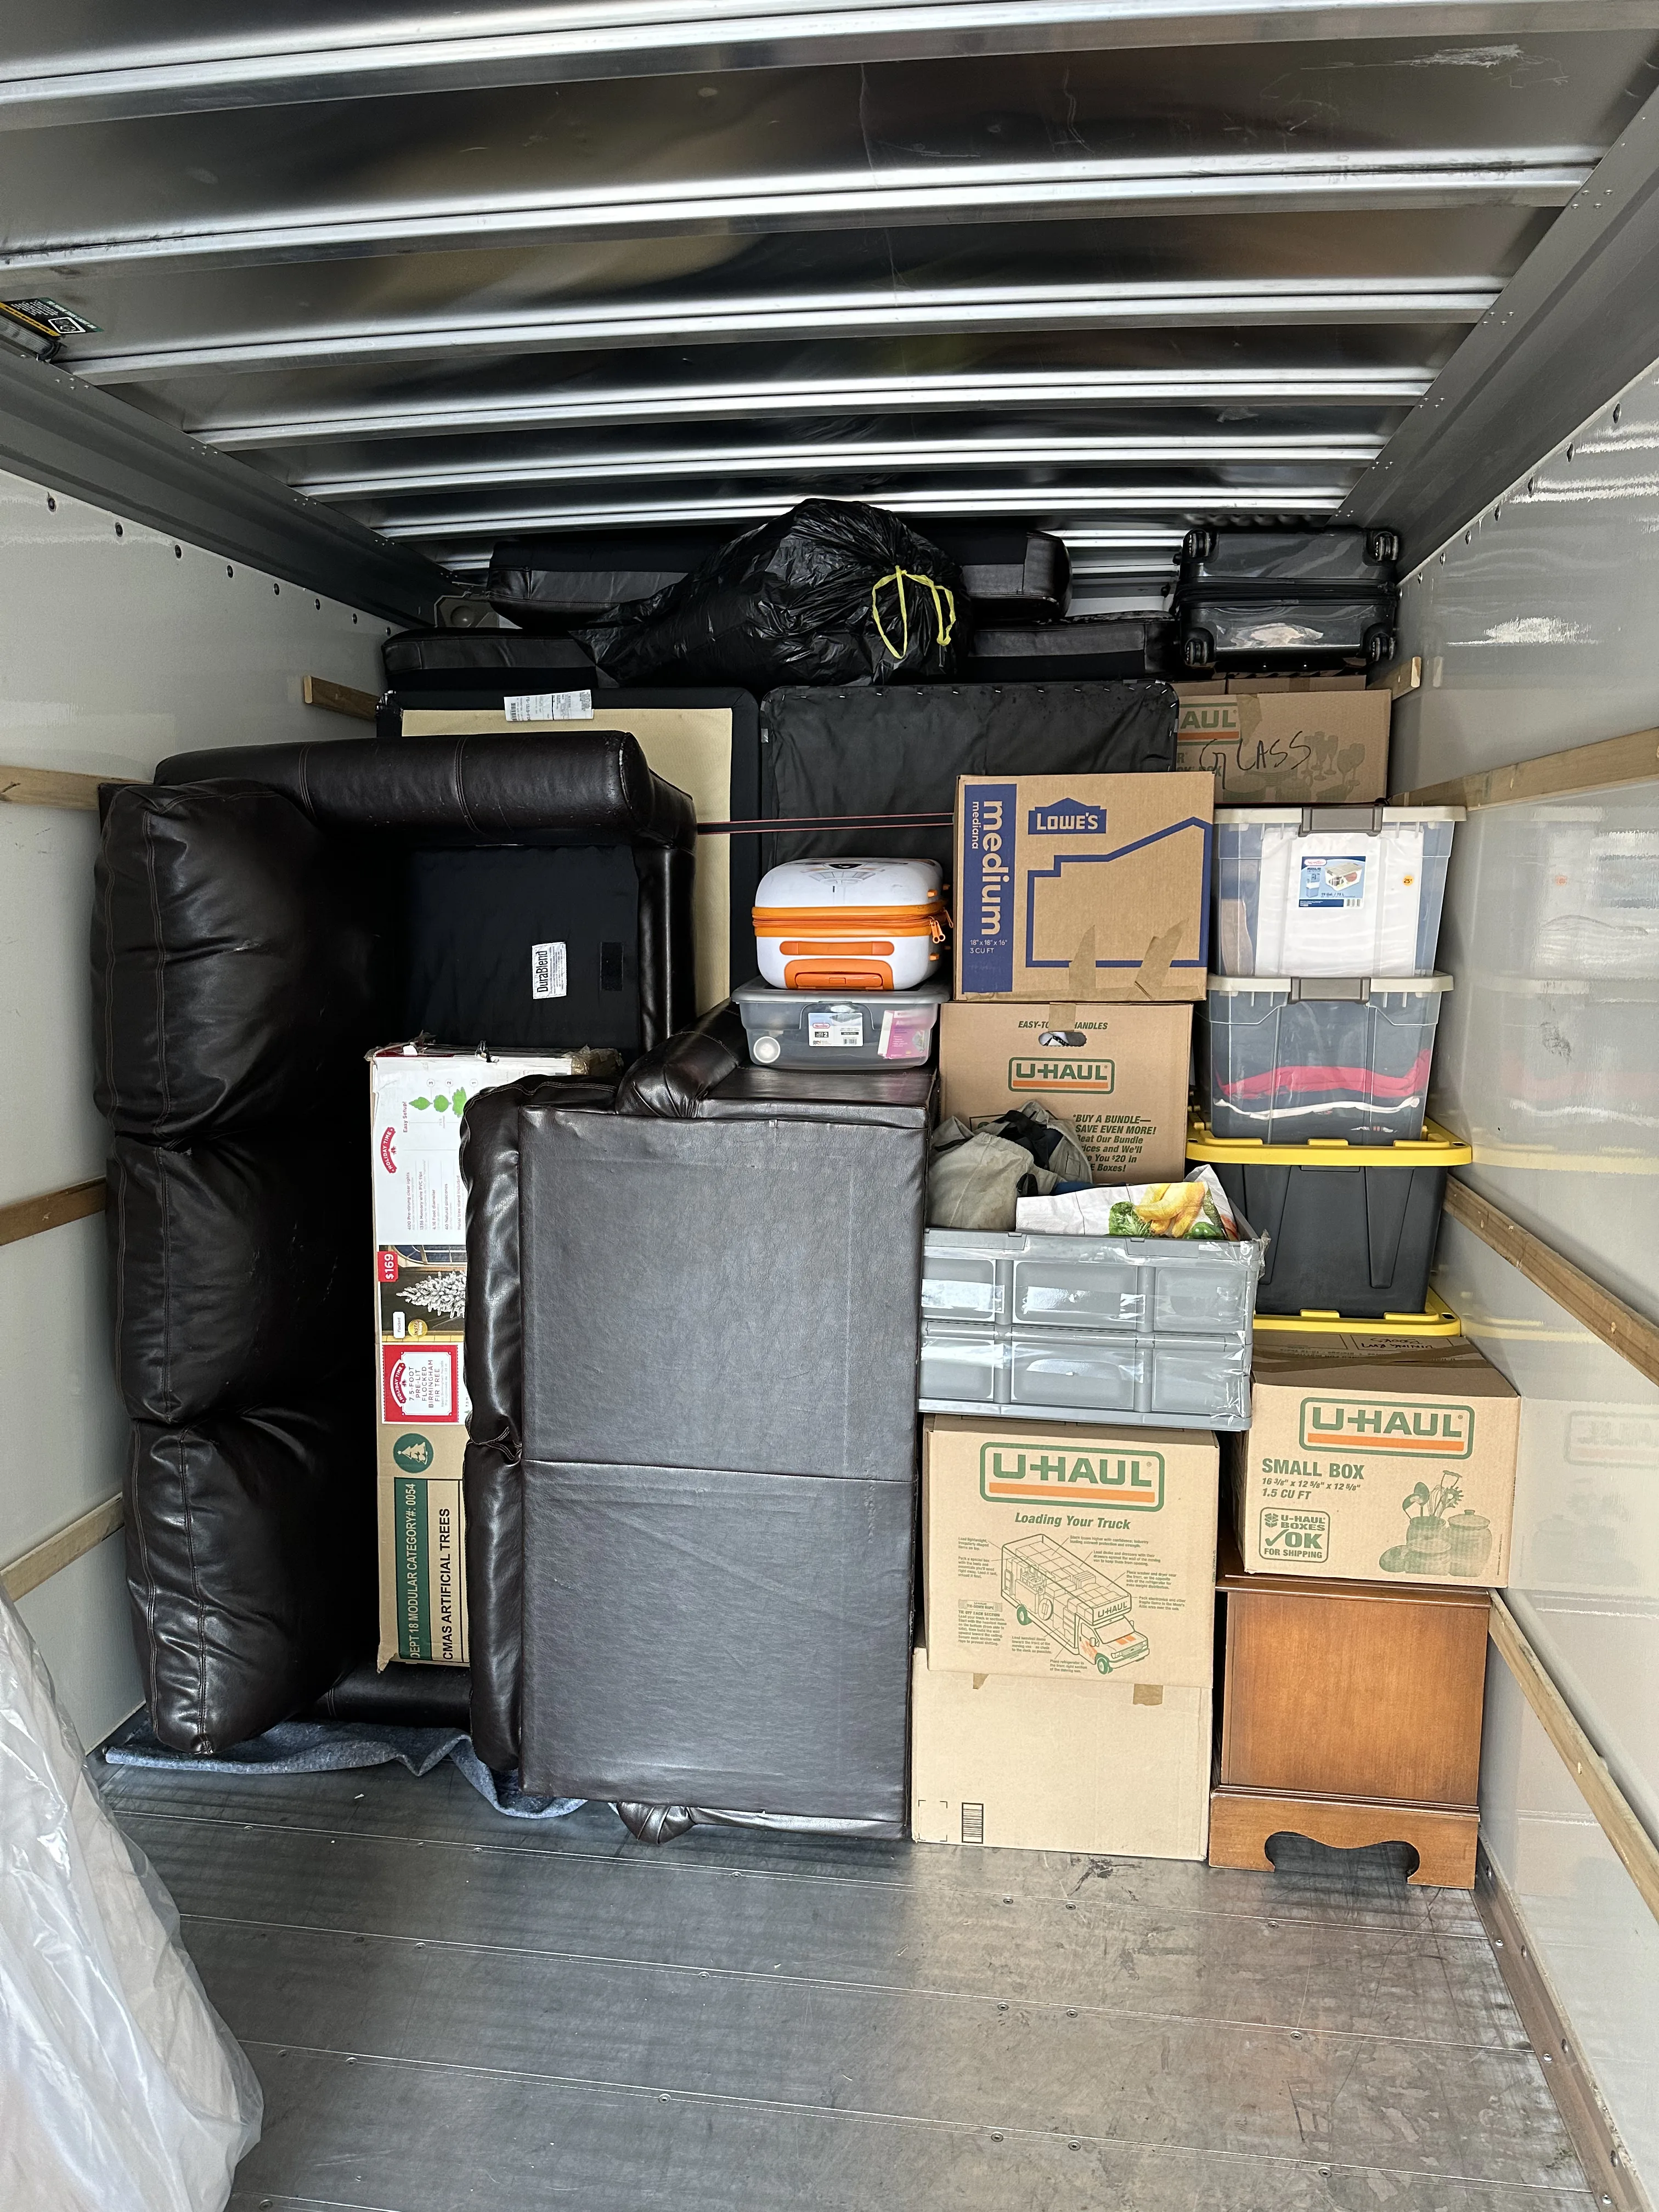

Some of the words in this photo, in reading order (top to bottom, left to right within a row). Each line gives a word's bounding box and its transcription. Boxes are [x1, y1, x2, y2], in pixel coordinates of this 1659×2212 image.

[1199, 731, 1311, 789] GLASS
[972, 802, 981, 849] mediana
[1037, 812, 1098, 830] LOWE'S
[981, 801, 1009, 935] medium
[535, 950, 549, 992] DuraBlend
[1017, 1063, 1108, 1080] U-HAUL
[1075, 1125, 1098, 1133] SAVE
[1100, 1125, 1124, 1133] EVEN
[1126, 1126, 1156, 1135] MORE!
[1096, 1115, 1102, 1123] A
[383, 1131, 392, 1144] TIME
[1114, 1136, 1143, 1144] Bundle
[383, 1145, 393, 1170] HOLIDAY
[385, 1254, 394, 1279] $169
[394, 1383, 404, 1401] HOLIDAY
[1312, 1407, 1462, 1437] U-HAUL
[994, 1453, 1152, 1487] U-HAUL
[1262, 1458, 1322, 1477] SMALL
[1329, 1463, 1365, 1480] BOX
[405, 1483, 416, 1505] 0054
[1262, 1488, 1278, 1498] 1.5
[1281, 1489, 1295, 1498] CU
[1297, 1491, 1311, 1500] FT
[439, 1509, 450, 1551] TREES
[1015, 1512, 1062, 1528] Loading
[1067, 1516, 1093, 1528] Your
[1097, 1517, 1131, 1531] Truck
[1281, 1515, 1325, 1524] U-HAUL
[1281, 1522, 1325, 1531] BOXES
[406, 1508, 417, 1570] CATEGORY#:
[1285, 1532, 1323, 1549] OK
[1283, 1549, 1322, 1559] SHIPPING
[407, 1572, 419, 1622] MODULAR
[440, 1554, 452, 1623] ARTIFICIAL
[409, 1623, 419, 1633] 18
[409, 1635, 420, 1658] DEPT
[442, 1626, 453, 1660] CMAS
